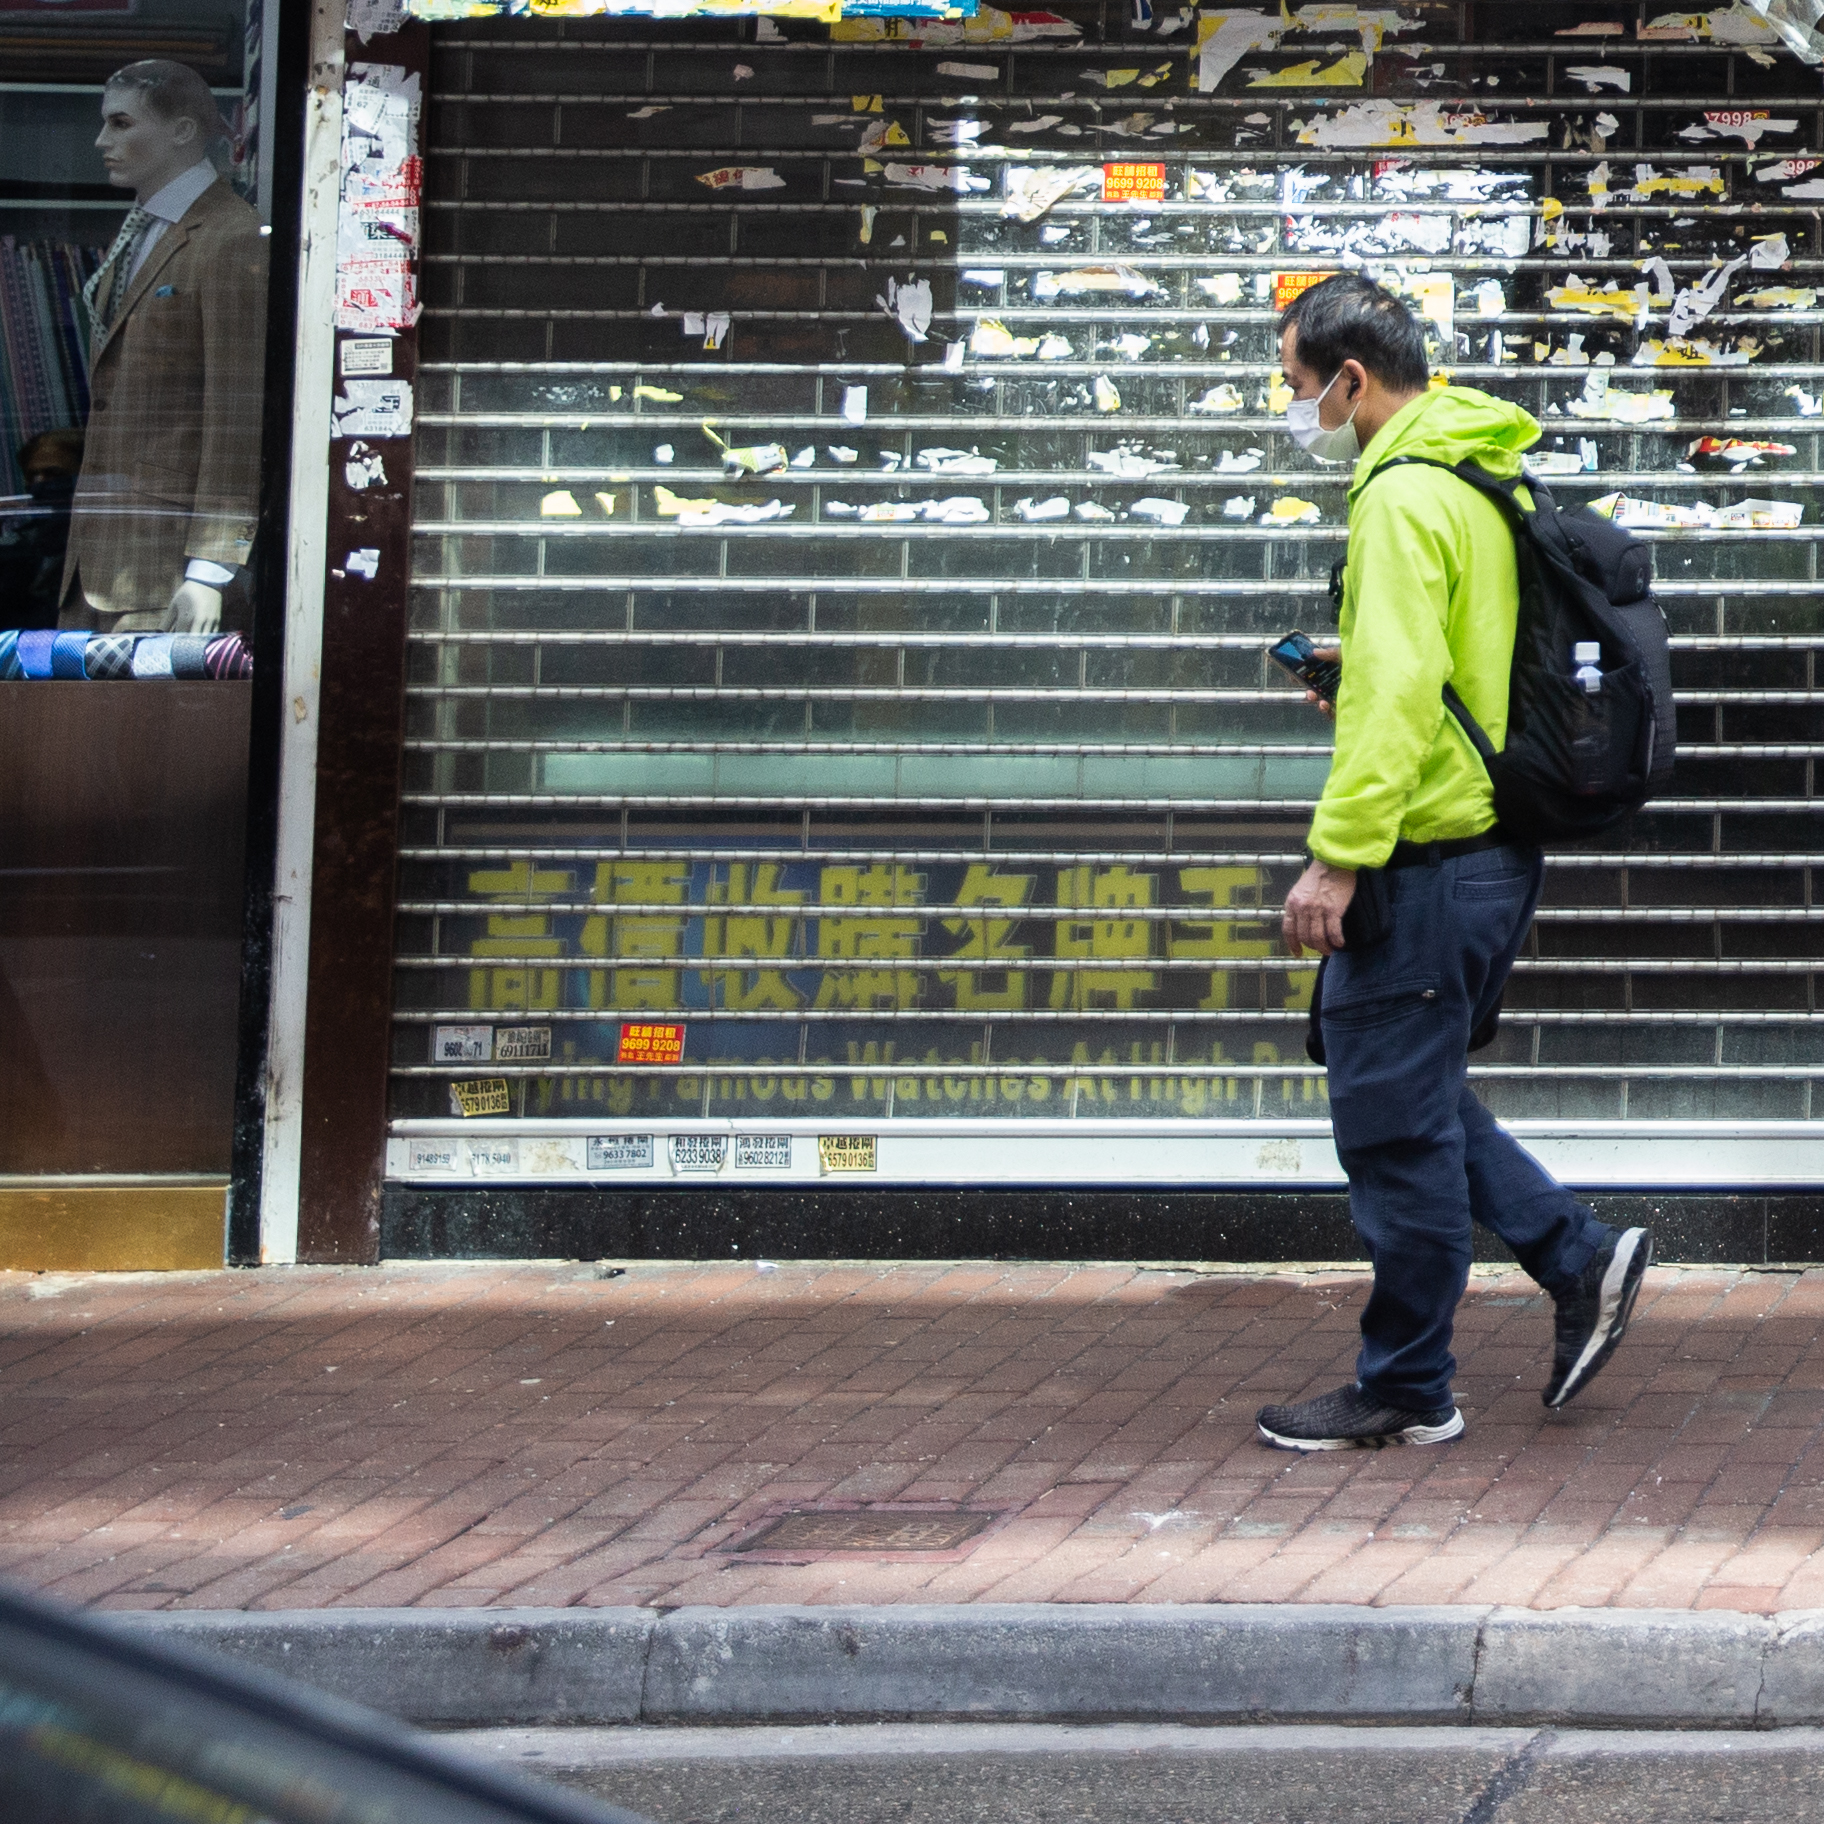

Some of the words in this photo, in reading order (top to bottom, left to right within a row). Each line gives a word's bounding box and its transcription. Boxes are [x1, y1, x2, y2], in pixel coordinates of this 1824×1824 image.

[1106, 178, 1134, 190] 9699
[1136, 178, 1164, 190] 9208
[621, 1038, 650, 1050] 9699
[652, 1039, 681, 1052] 9208
[603, 1150, 624, 1160] 9633
[626, 1149, 647, 1159] 7802
